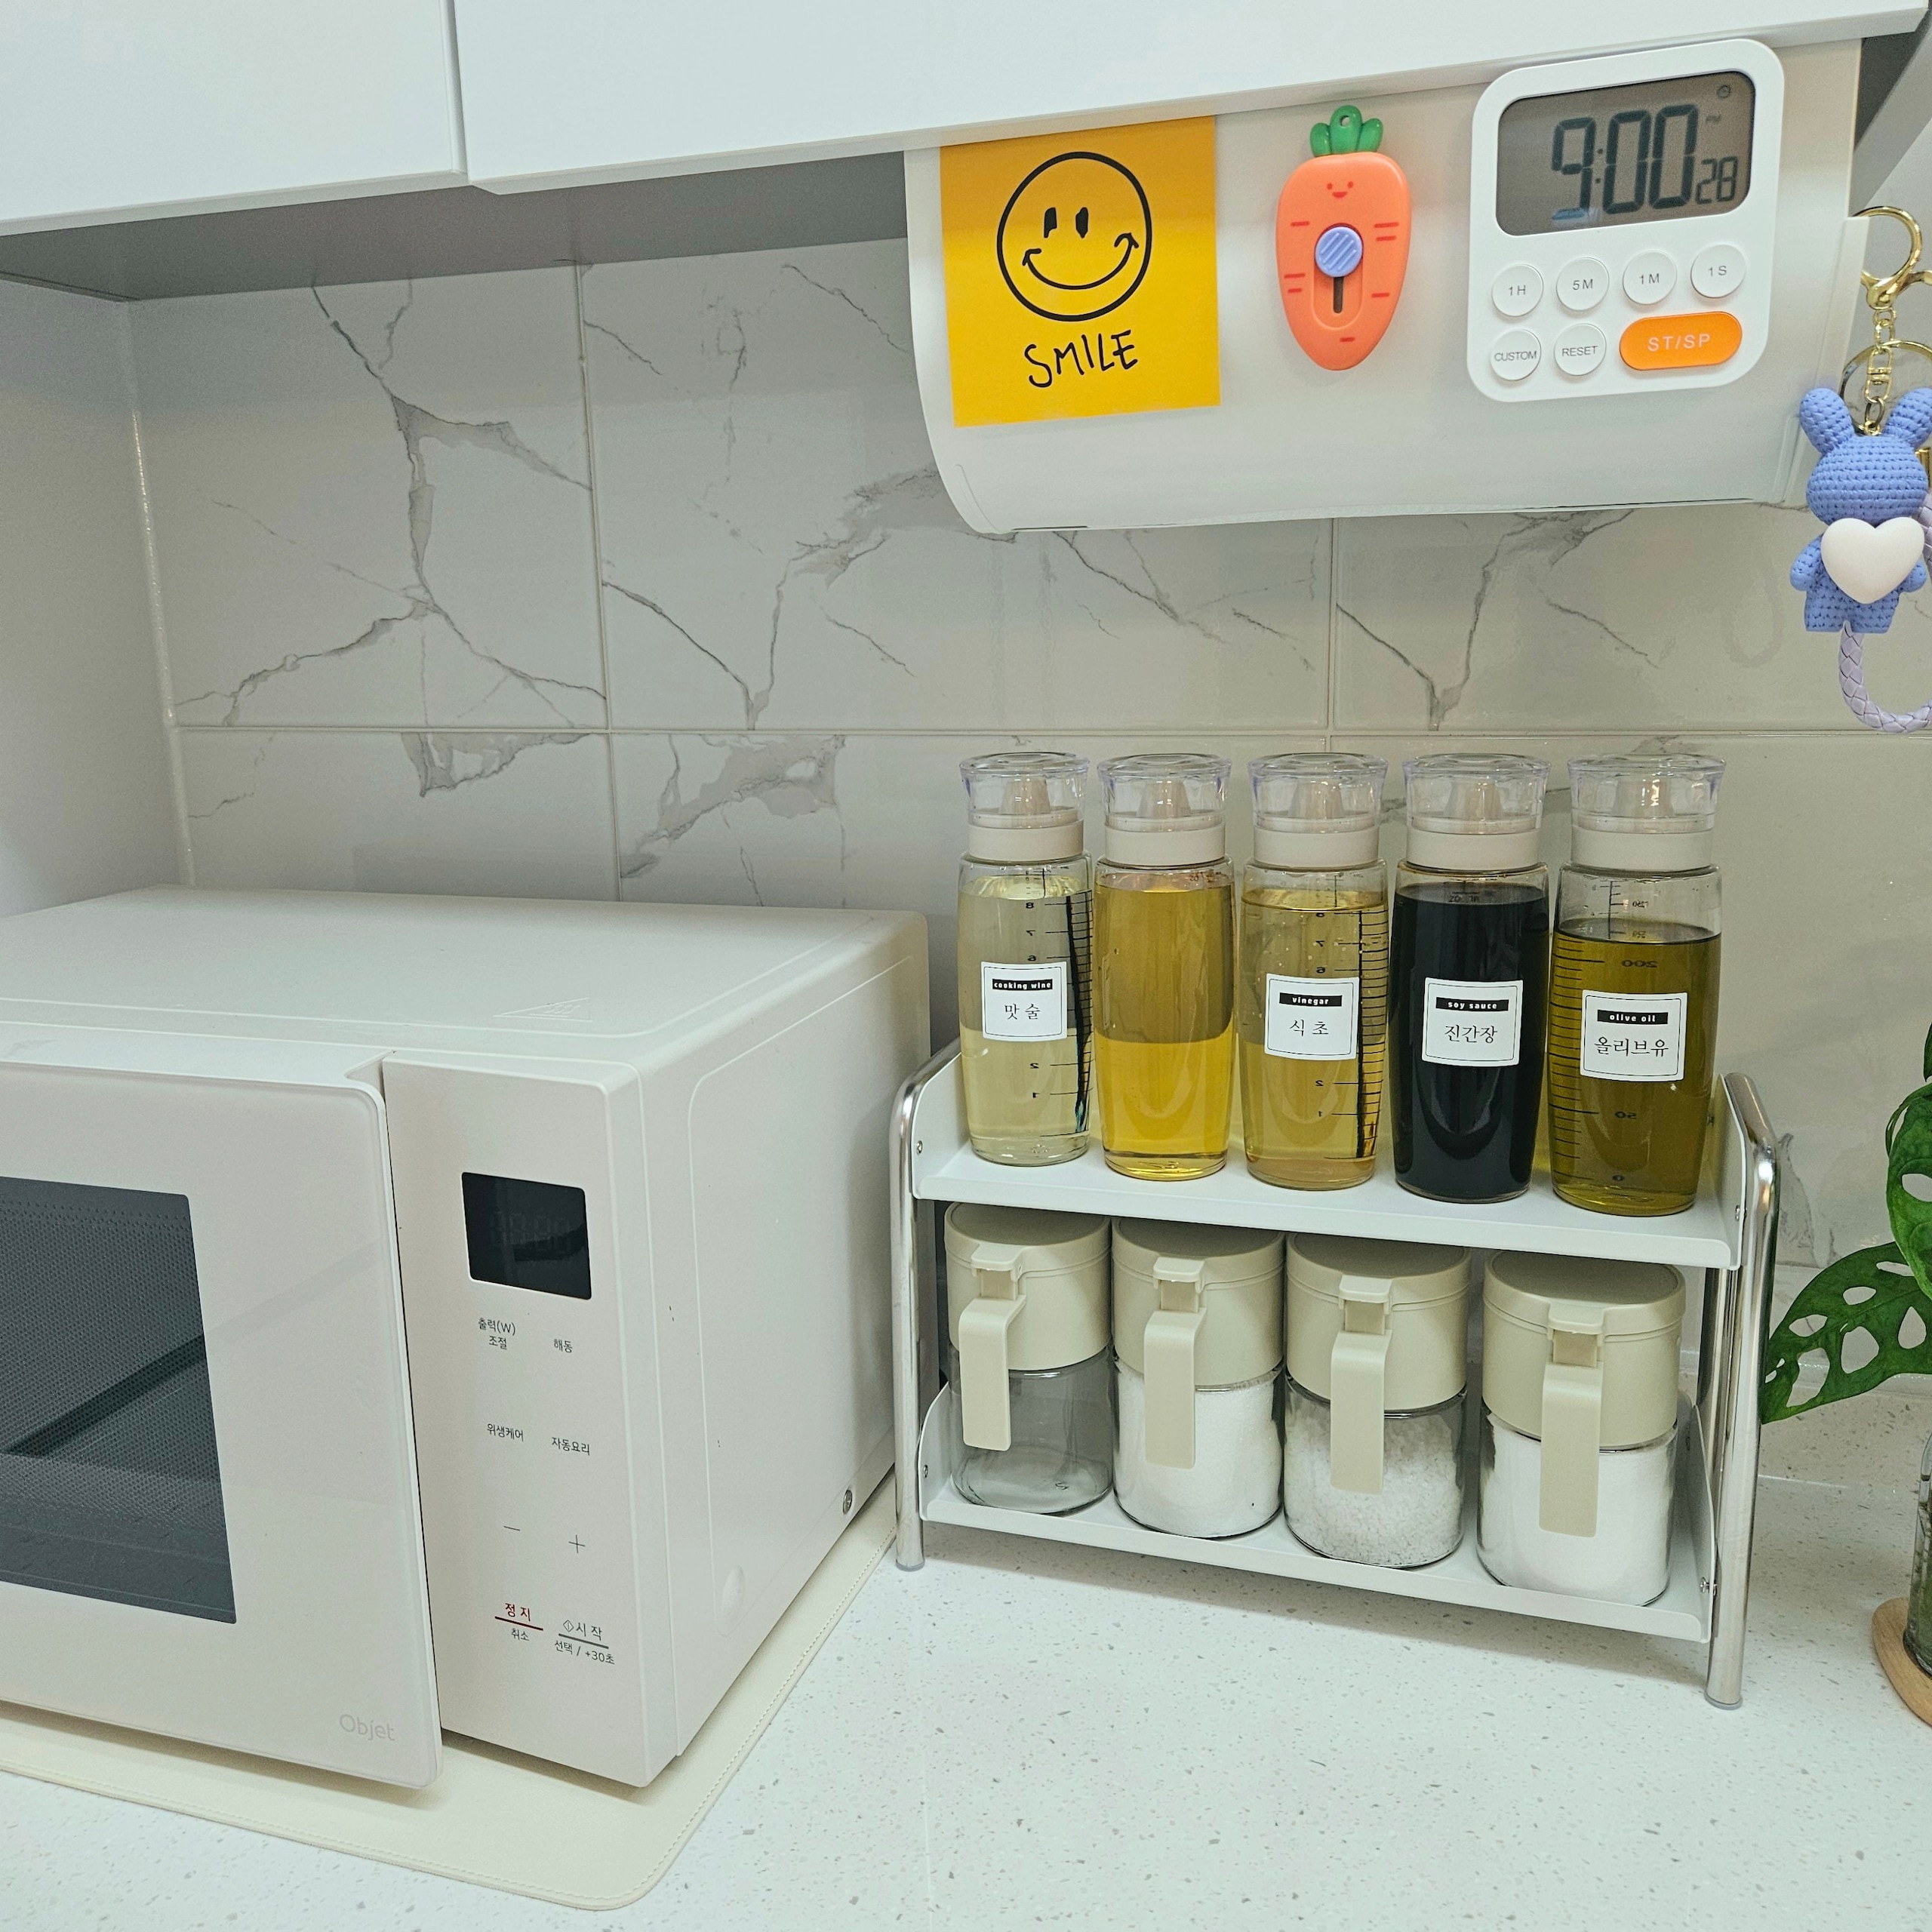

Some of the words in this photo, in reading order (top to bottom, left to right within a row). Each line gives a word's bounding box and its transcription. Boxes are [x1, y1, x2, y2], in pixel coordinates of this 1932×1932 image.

[1552, 103, 1699, 221] 9:00
[1696, 155, 1739, 205] 28
[1572, 278, 1594, 291] 5M
[1647, 333, 1711, 352] ST/SP
[1023, 329, 1139, 389] SMILE
[1494, 349, 1537, 362] CUSTOM
[1561, 345, 1598, 358] RESET
[993, 982, 1028, 990] cooking
[1031, 981, 1051, 989] wine
[1292, 996, 1329, 1006] vinegar
[1447, 1001, 1466, 1010] soy
[1609, 1014, 1637, 1022] olive
[1641, 1014, 1657, 1023] oil
[1444, 1024, 1498, 1044] 진간장
[1594, 1036, 1669, 1057] 올리브유
[478, 1317, 516, 1335] 출력(W)
[488, 1335, 508, 1350] 조절
[553, 1338, 573, 1353] 해동
[486, 1423, 525, 1442] 위생케어
[551, 1437, 591, 1456] 자동요리
[510, 1627, 531, 1641] 취소
[554, 1639, 574, 1655] 선택
[585, 1650, 616, 1665] +30초
[339, 1713, 396, 1742] Objet
